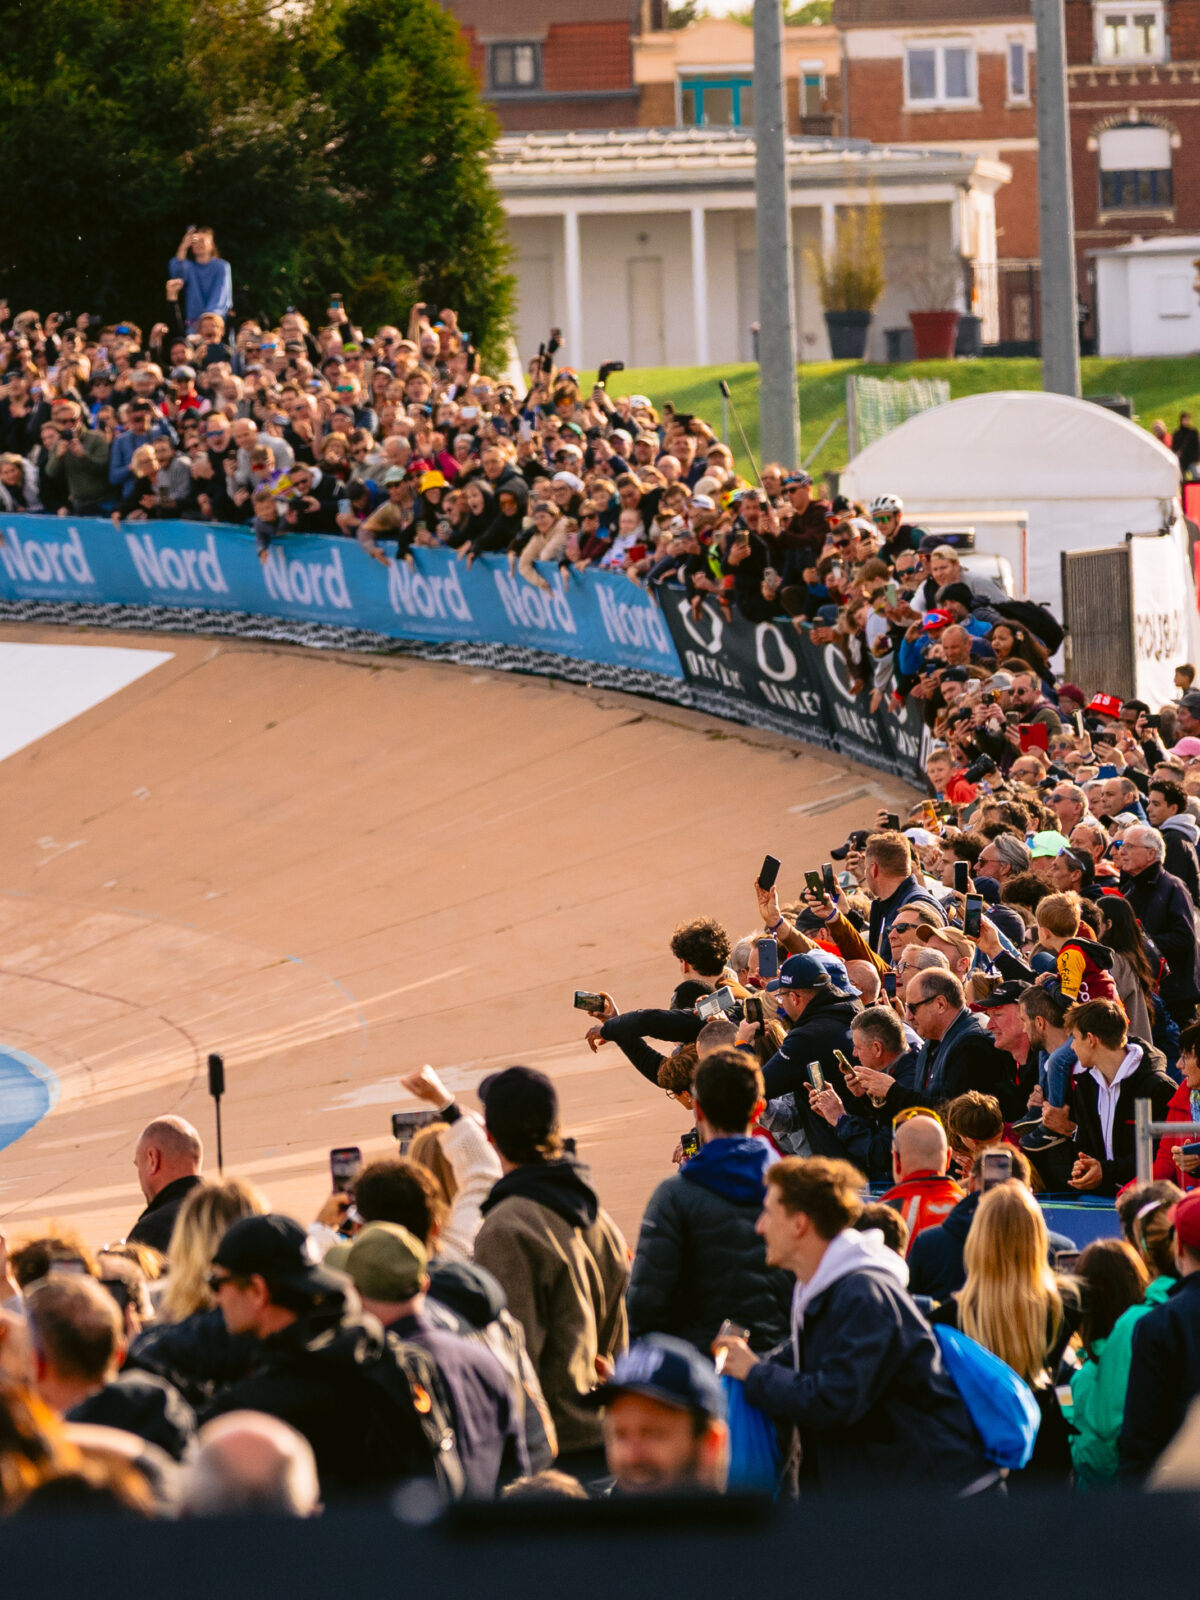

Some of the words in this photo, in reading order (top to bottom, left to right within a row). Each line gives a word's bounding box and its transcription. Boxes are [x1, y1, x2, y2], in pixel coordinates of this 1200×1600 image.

[1, 526, 96, 585] Nord
[125, 532, 229, 594] Nord
[262, 546, 353, 609] Nord
[388, 558, 474, 622] Nord
[494, 569, 577, 634] Nord
[595, 583, 671, 655] Nord
